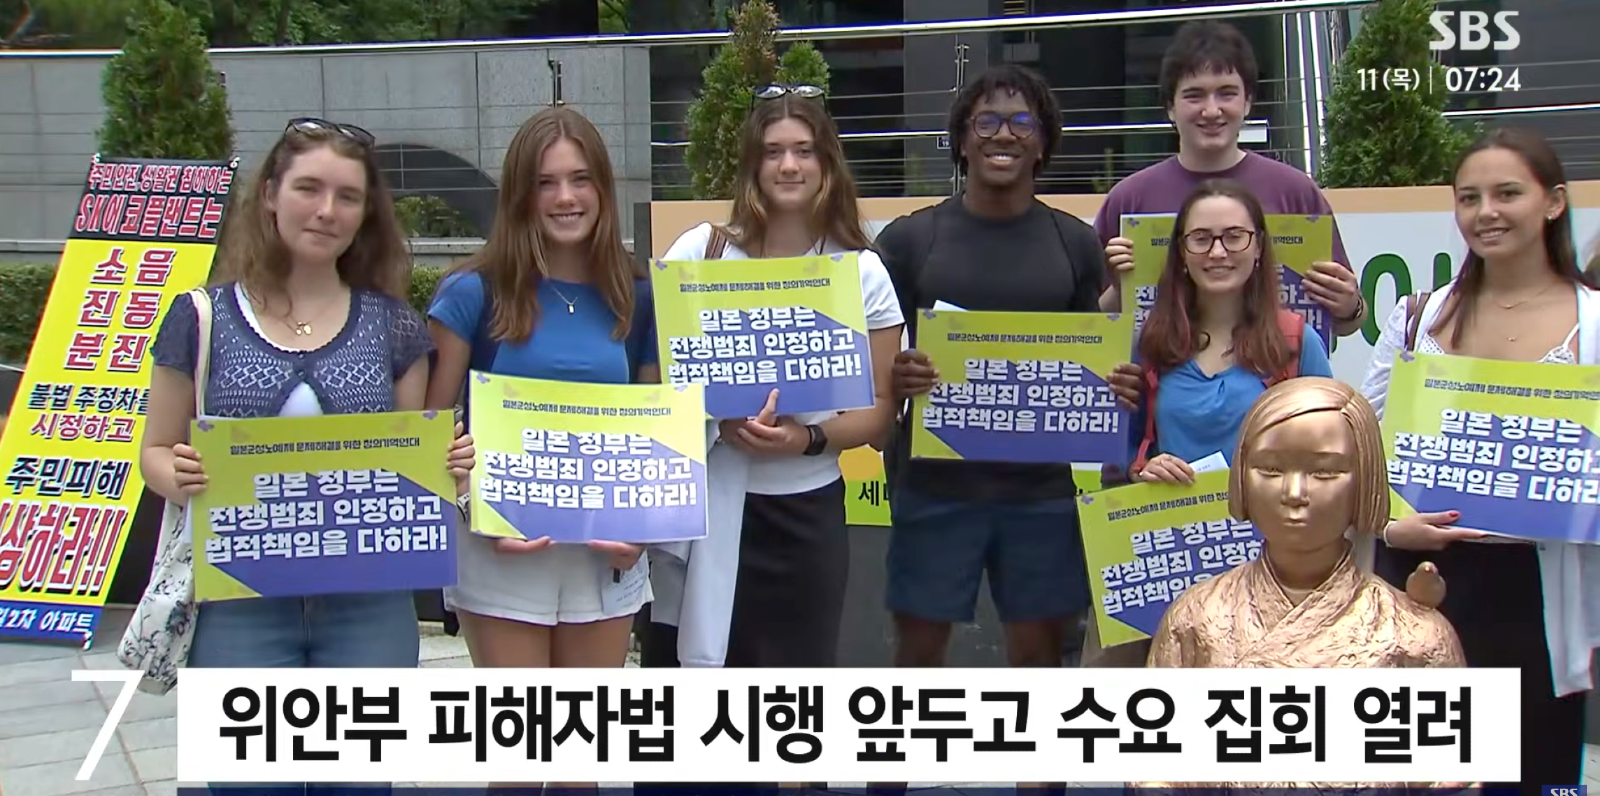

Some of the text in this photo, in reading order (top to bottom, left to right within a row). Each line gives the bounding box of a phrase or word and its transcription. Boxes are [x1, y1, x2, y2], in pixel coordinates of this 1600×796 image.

[179, 166, 234, 195] 침해하는
[75, 194, 224, 238] SK에코플랜트는
[699, 306, 816, 331] 일본 정부는
[668, 328, 855, 360] 전쟁범죄 인정하고
[668, 354, 862, 386] 법적책임을 다하라!
[964, 358, 1082, 382] 일본 정부는
[27, 384, 72, 411] 불법
[1027, 385, 1116, 408] 인정하고
[31, 413, 136, 442] 시정하고
[922, 407, 1118, 434] 법적책임을 다하라!
[1440, 408, 1582, 443] 일본 정부는
[521, 428, 652, 455] 일본 정부는
[1394, 431, 1600, 475] 전쟁범죄 인정하
[5, 456, 132, 500] 주민피해
[484, 452, 692, 482] 전쟁범죄 인정하고
[1387, 459, 1520, 498] 법적책임을
[253, 468, 399, 499] 일본 정부는
[479, 477, 697, 509] 법적책임을 다하라!
[209, 496, 442, 533] 전쟁범죄 인정하고
[0, 500, 128, 596] 상하라!!
[205, 526, 447, 564] 법적책임을 다하라!
[1130, 518, 1253, 555] 일본 정부는
[1100, 539, 1266, 588] 전쟁범죄 인정하
[39, 610, 94, 633] 아파트
